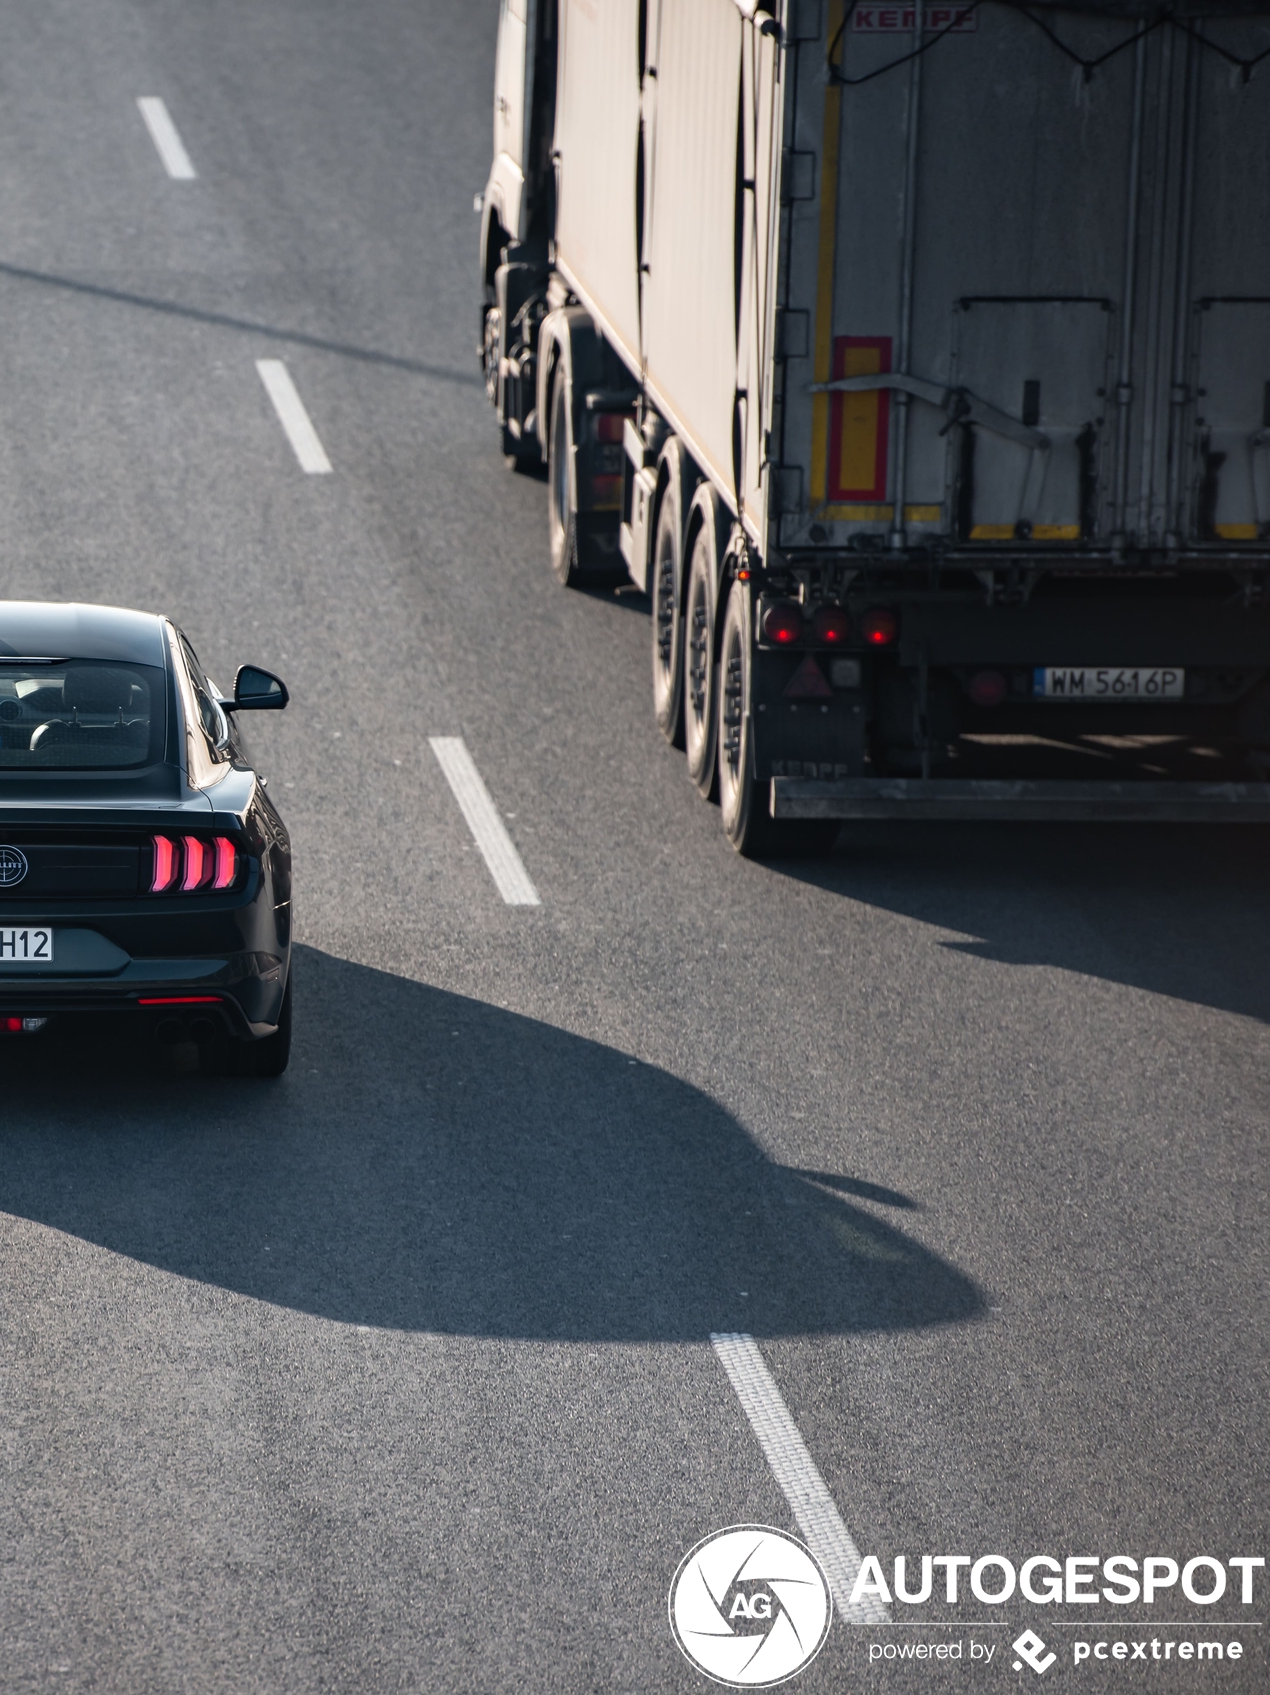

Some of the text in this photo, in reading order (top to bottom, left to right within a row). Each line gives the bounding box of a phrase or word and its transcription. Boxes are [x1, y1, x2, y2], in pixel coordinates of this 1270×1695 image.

[855, 9, 974, 28] KEMPF
[1051, 670, 1177, 694] WM 5616P
[0, 931, 48, 957] H12
